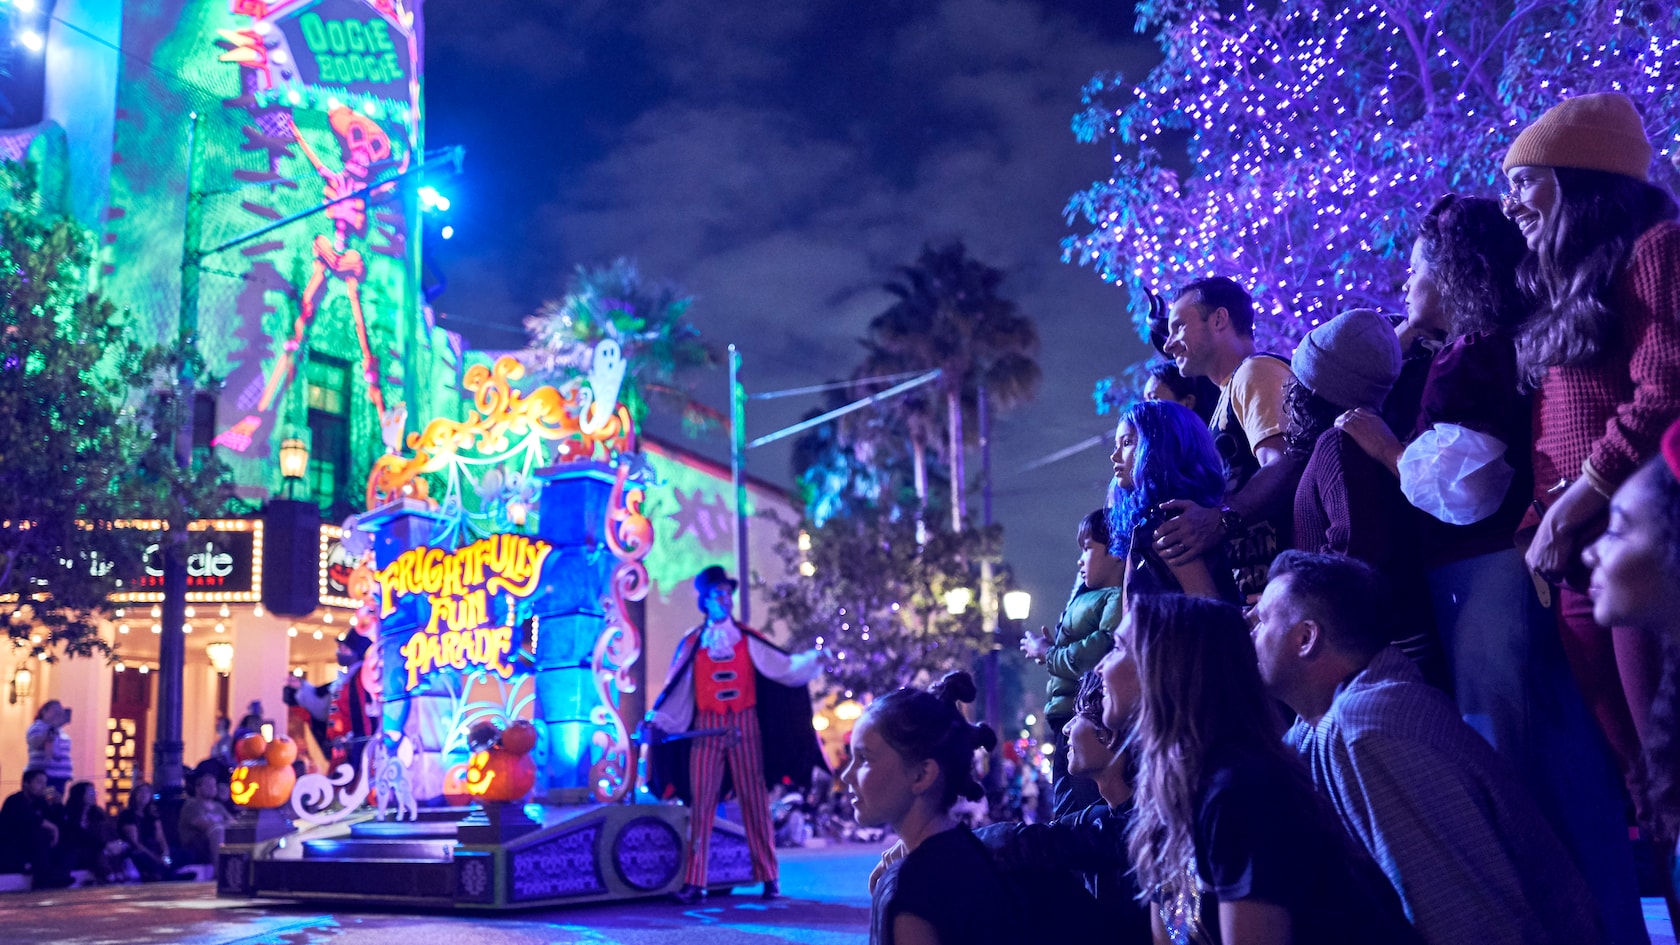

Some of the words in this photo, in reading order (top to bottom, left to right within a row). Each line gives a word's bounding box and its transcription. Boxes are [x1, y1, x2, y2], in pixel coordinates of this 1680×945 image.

[301, 12, 394, 53] OOGIE
[315, 51, 404, 84] BOOGIE
[374, 533, 553, 619] FRIGHTFULLY
[424, 589, 490, 634] FUN
[400, 626, 514, 692] PARADE
